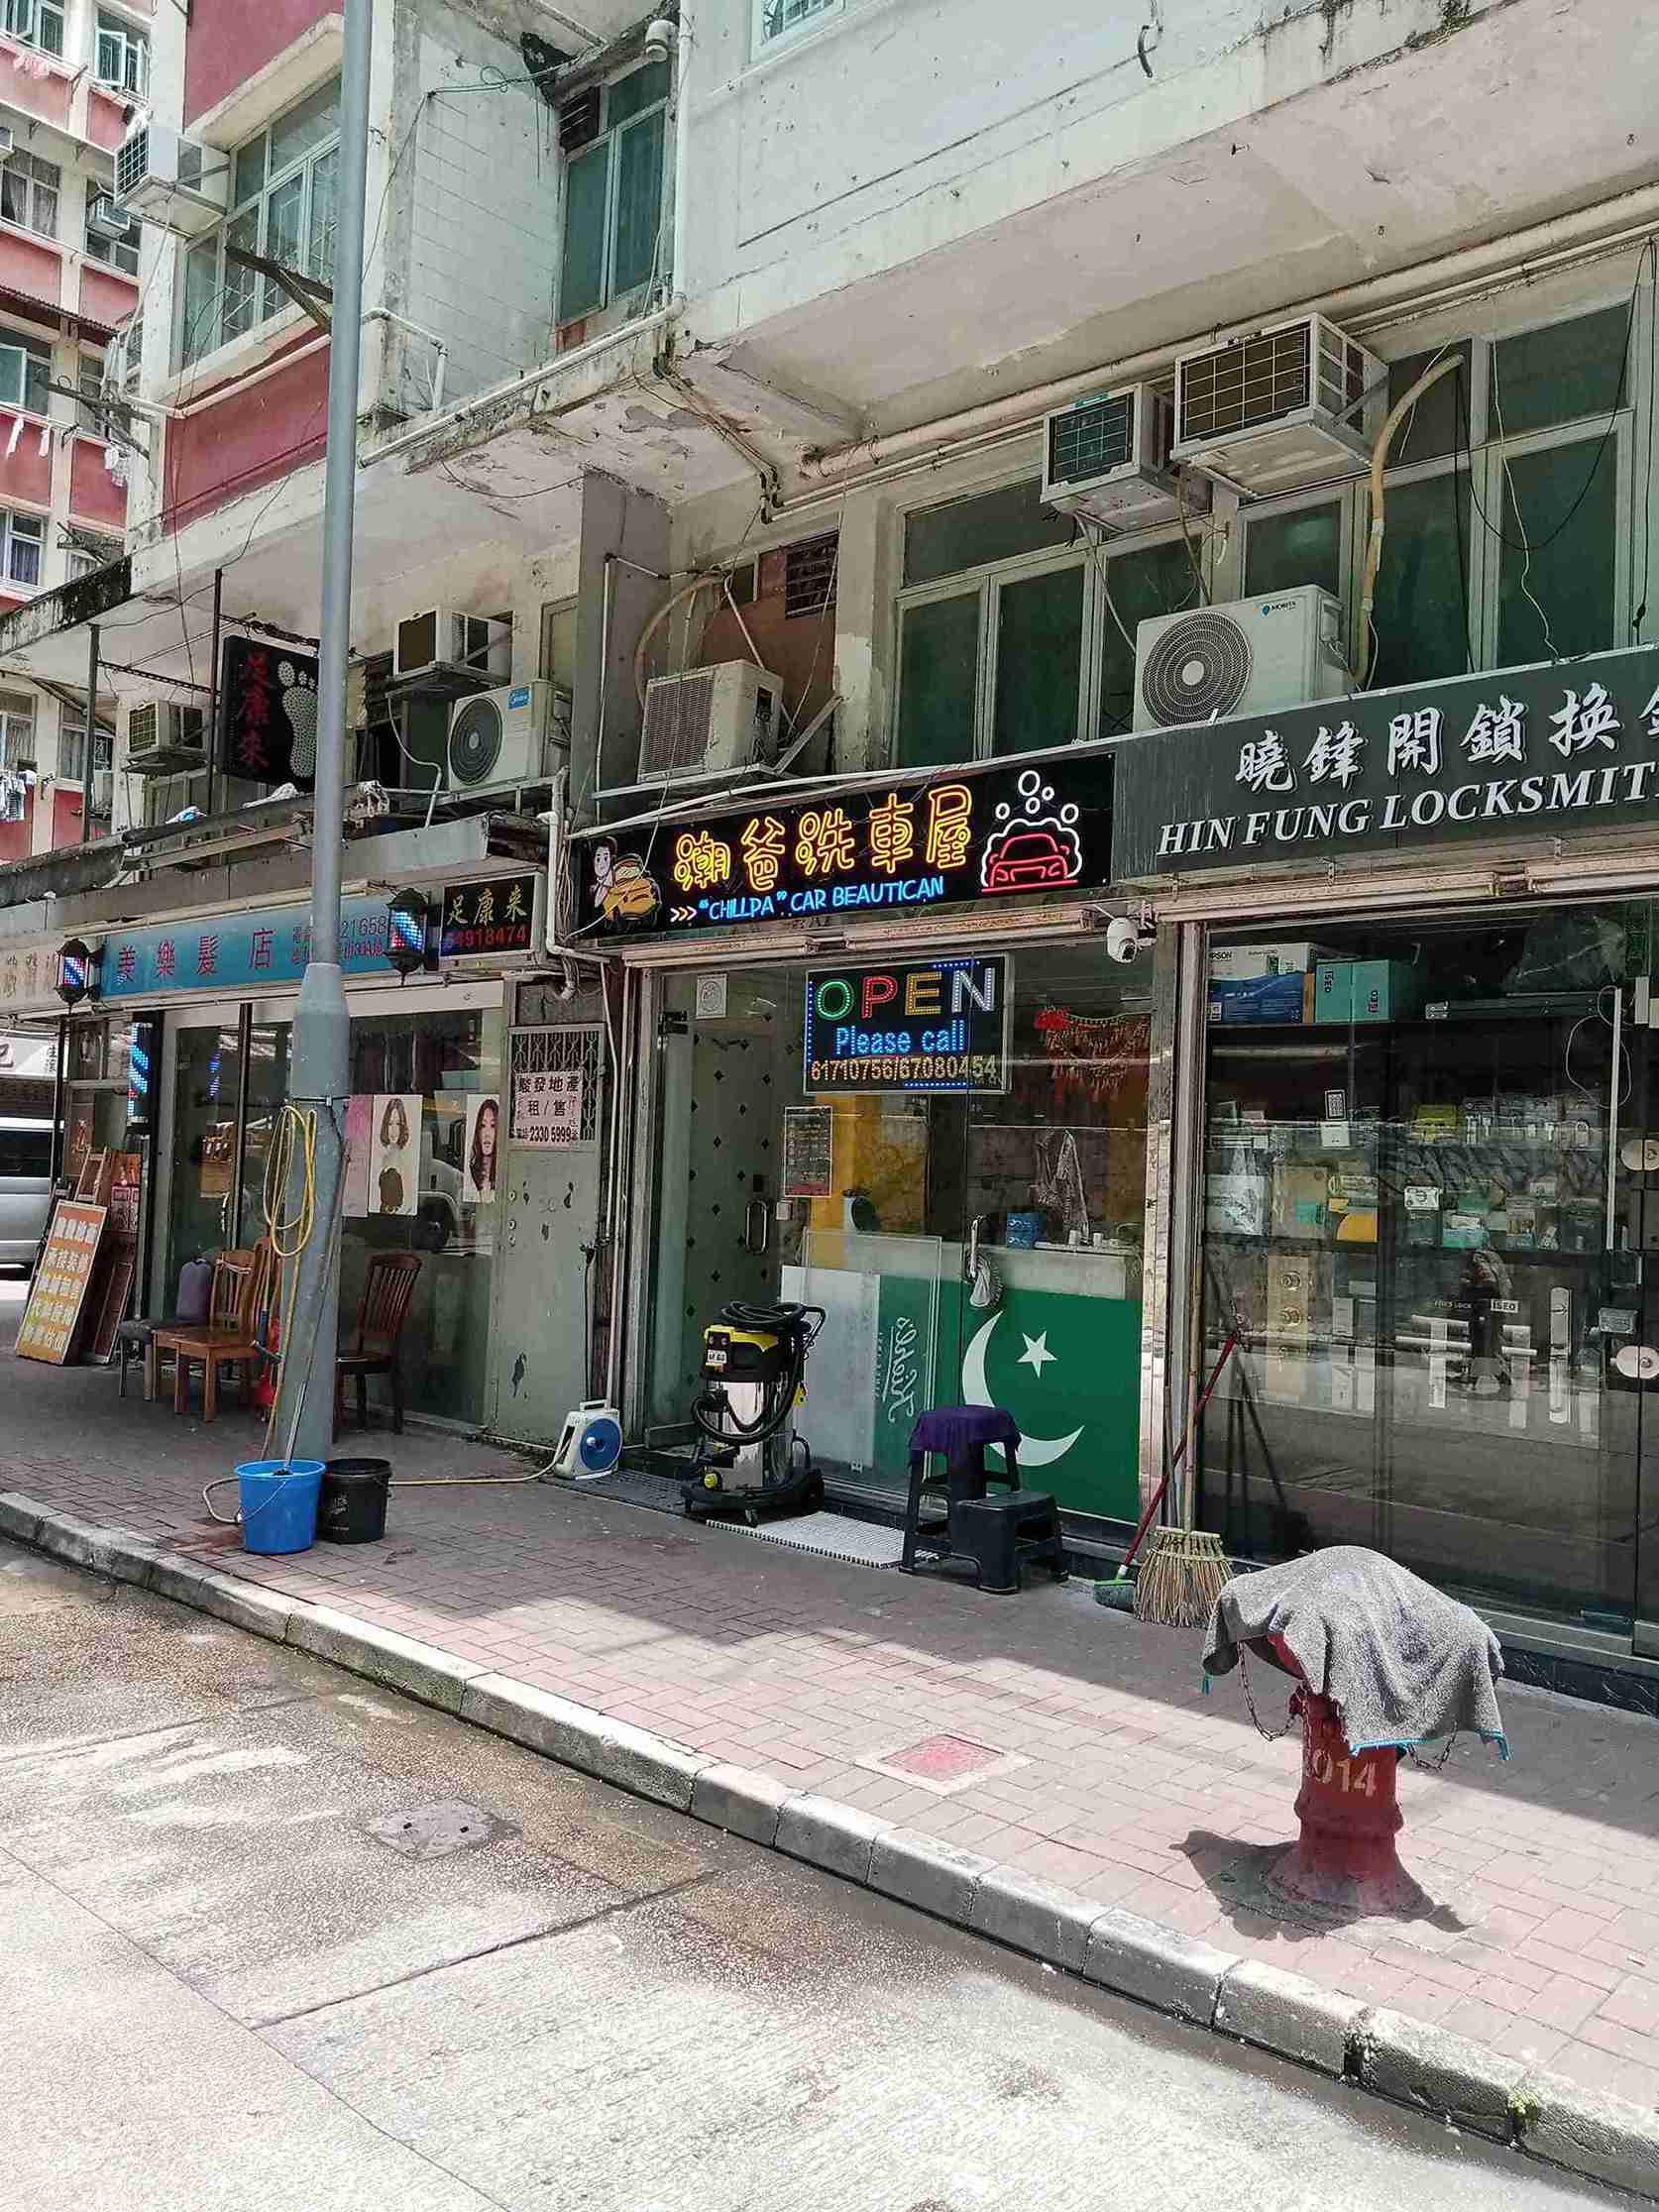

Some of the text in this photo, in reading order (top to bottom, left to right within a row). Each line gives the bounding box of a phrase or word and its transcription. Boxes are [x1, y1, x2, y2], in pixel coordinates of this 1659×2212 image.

[1236, 682, 1659, 794] 曉鋒開鎖換
[1156, 759, 1659, 856] HIN FUNG LOCKSMIT
[674, 784, 972, 892] 潮爸洗車屋
[790, 888, 827, 912] CAR
[832, 875, 944, 907] BEAUTICAN
[815, 967, 996, 1021] OPEN
[835, 1019, 964, 1055] Please call
[1312, 1748, 1377, 1797] 014
